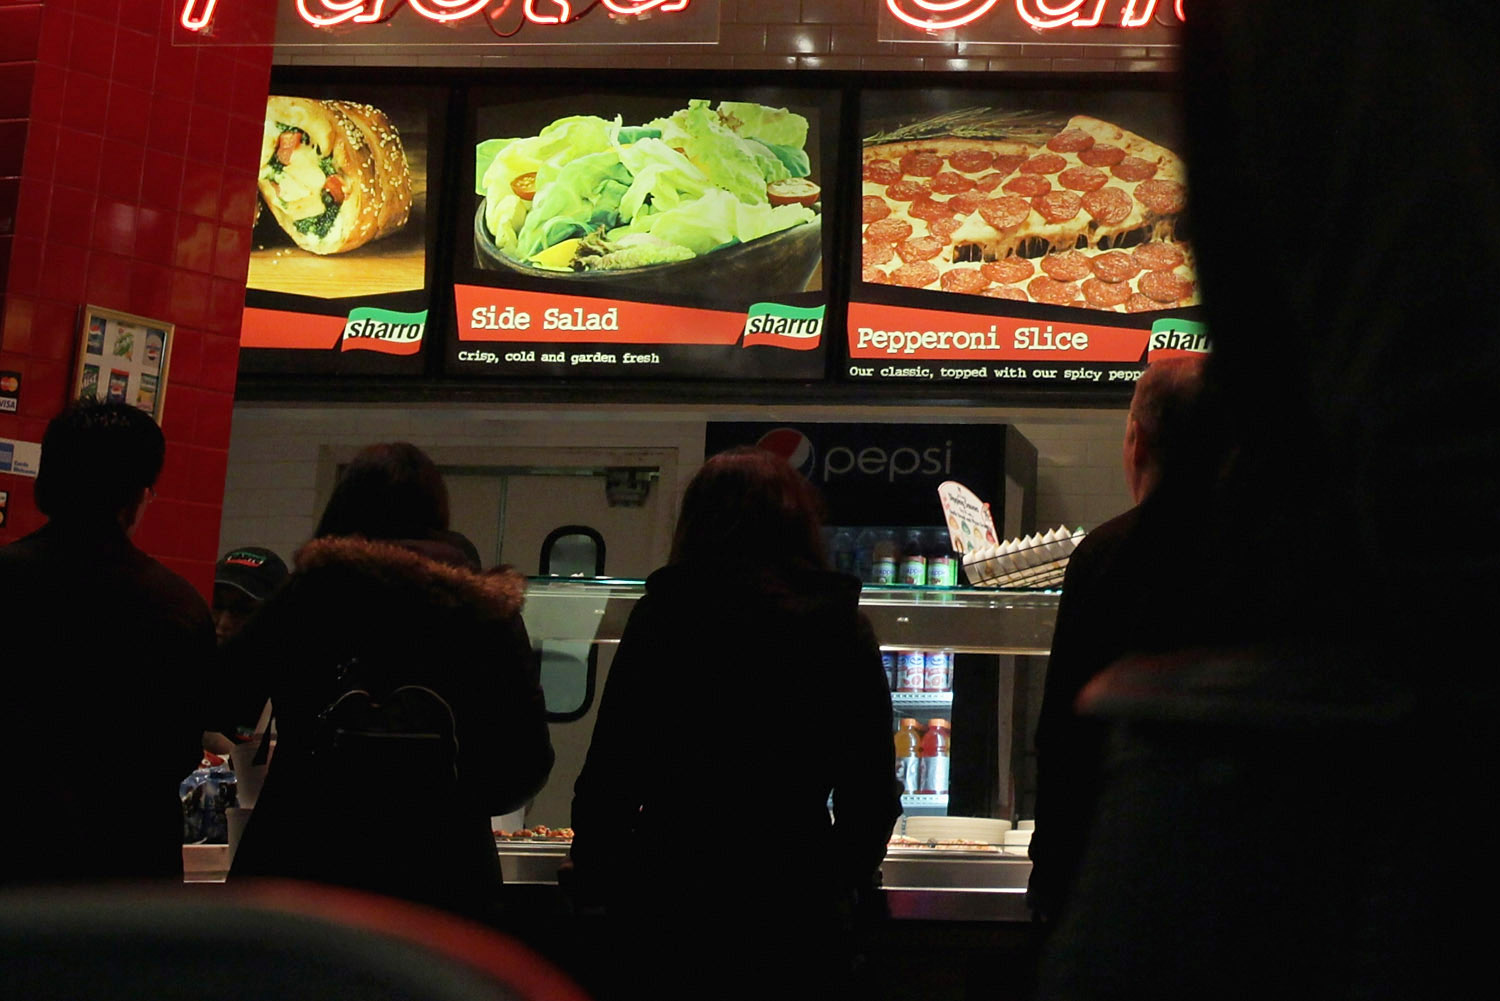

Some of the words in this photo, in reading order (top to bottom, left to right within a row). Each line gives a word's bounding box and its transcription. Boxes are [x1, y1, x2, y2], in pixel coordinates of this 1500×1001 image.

[348, 318, 421, 340] sbarro
[471, 305, 531, 330] Side
[543, 307, 618, 331] Salad
[749, 313, 819, 335] sbarro
[857, 325, 1001, 354] Pepperoni
[1014, 326, 1088, 350] Slice
[458, 351, 499, 364] Crisp,
[505, 352, 535, 362] cold
[541, 352, 565, 363] and
[571, 353, 616, 365] garden
[622, 353, 660, 364] fresh
[849, 367, 875, 377] Our
[880, 367, 934, 379] classic,
[940, 367, 988, 379] topped
[994, 367, 1027, 378] with
[1033, 370, 1058, 379] our
[1064, 369, 1101, 382] spicy
[824, 440, 953, 482] pepsi
